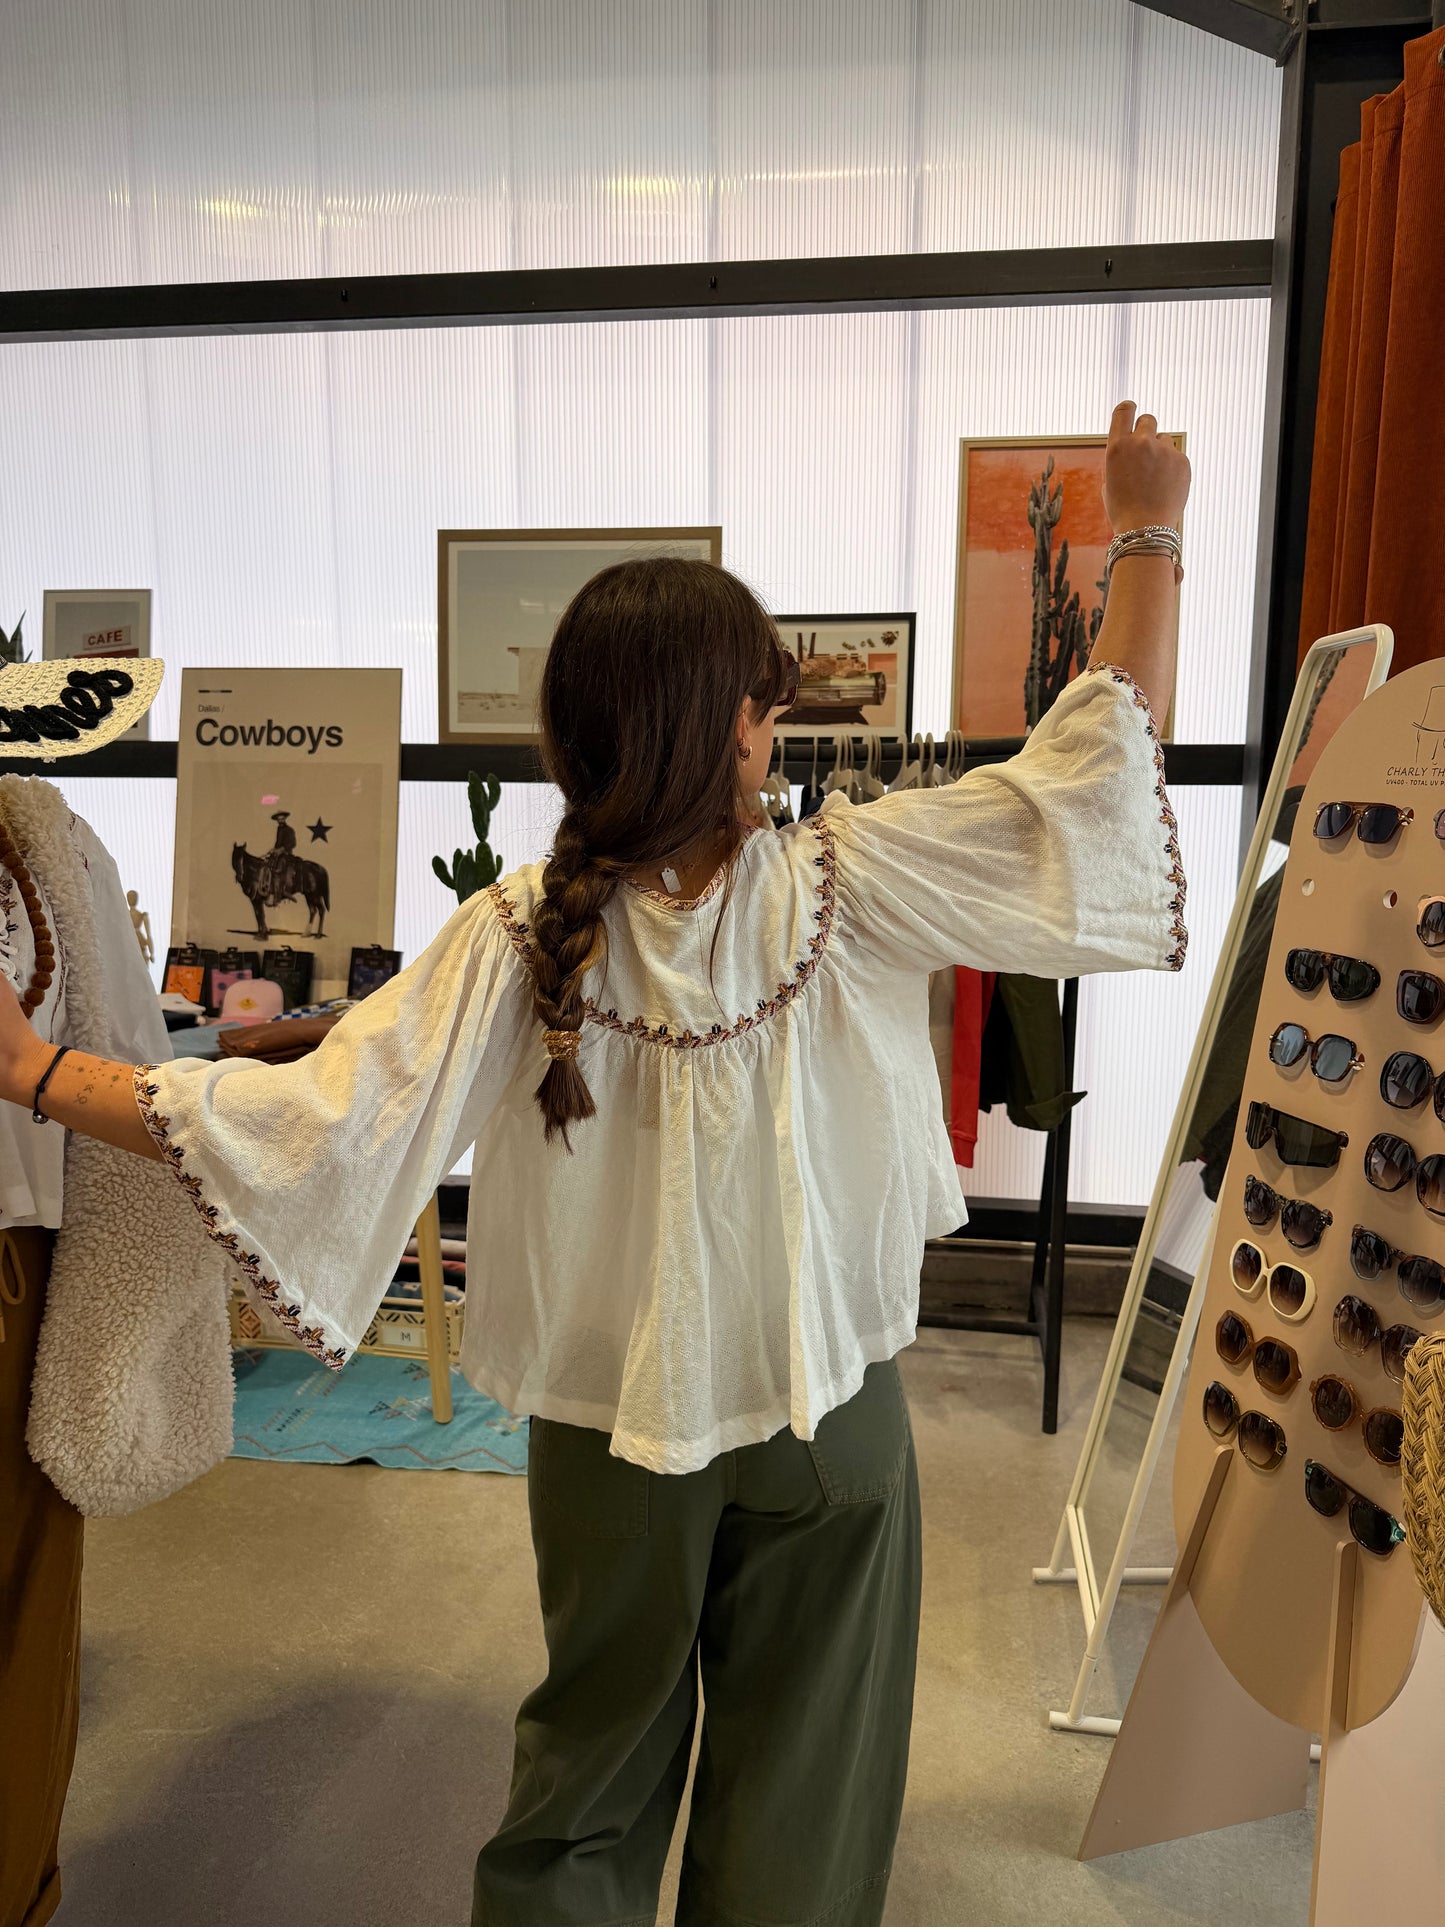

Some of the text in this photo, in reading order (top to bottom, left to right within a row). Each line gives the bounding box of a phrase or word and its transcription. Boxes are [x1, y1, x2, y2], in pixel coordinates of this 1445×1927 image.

[88, 630, 122, 646] CAFE
[196, 718, 343, 754] Cowboys
[1387, 766, 1428, 776] CHARLY
[401, 1331, 411, 1341] M
